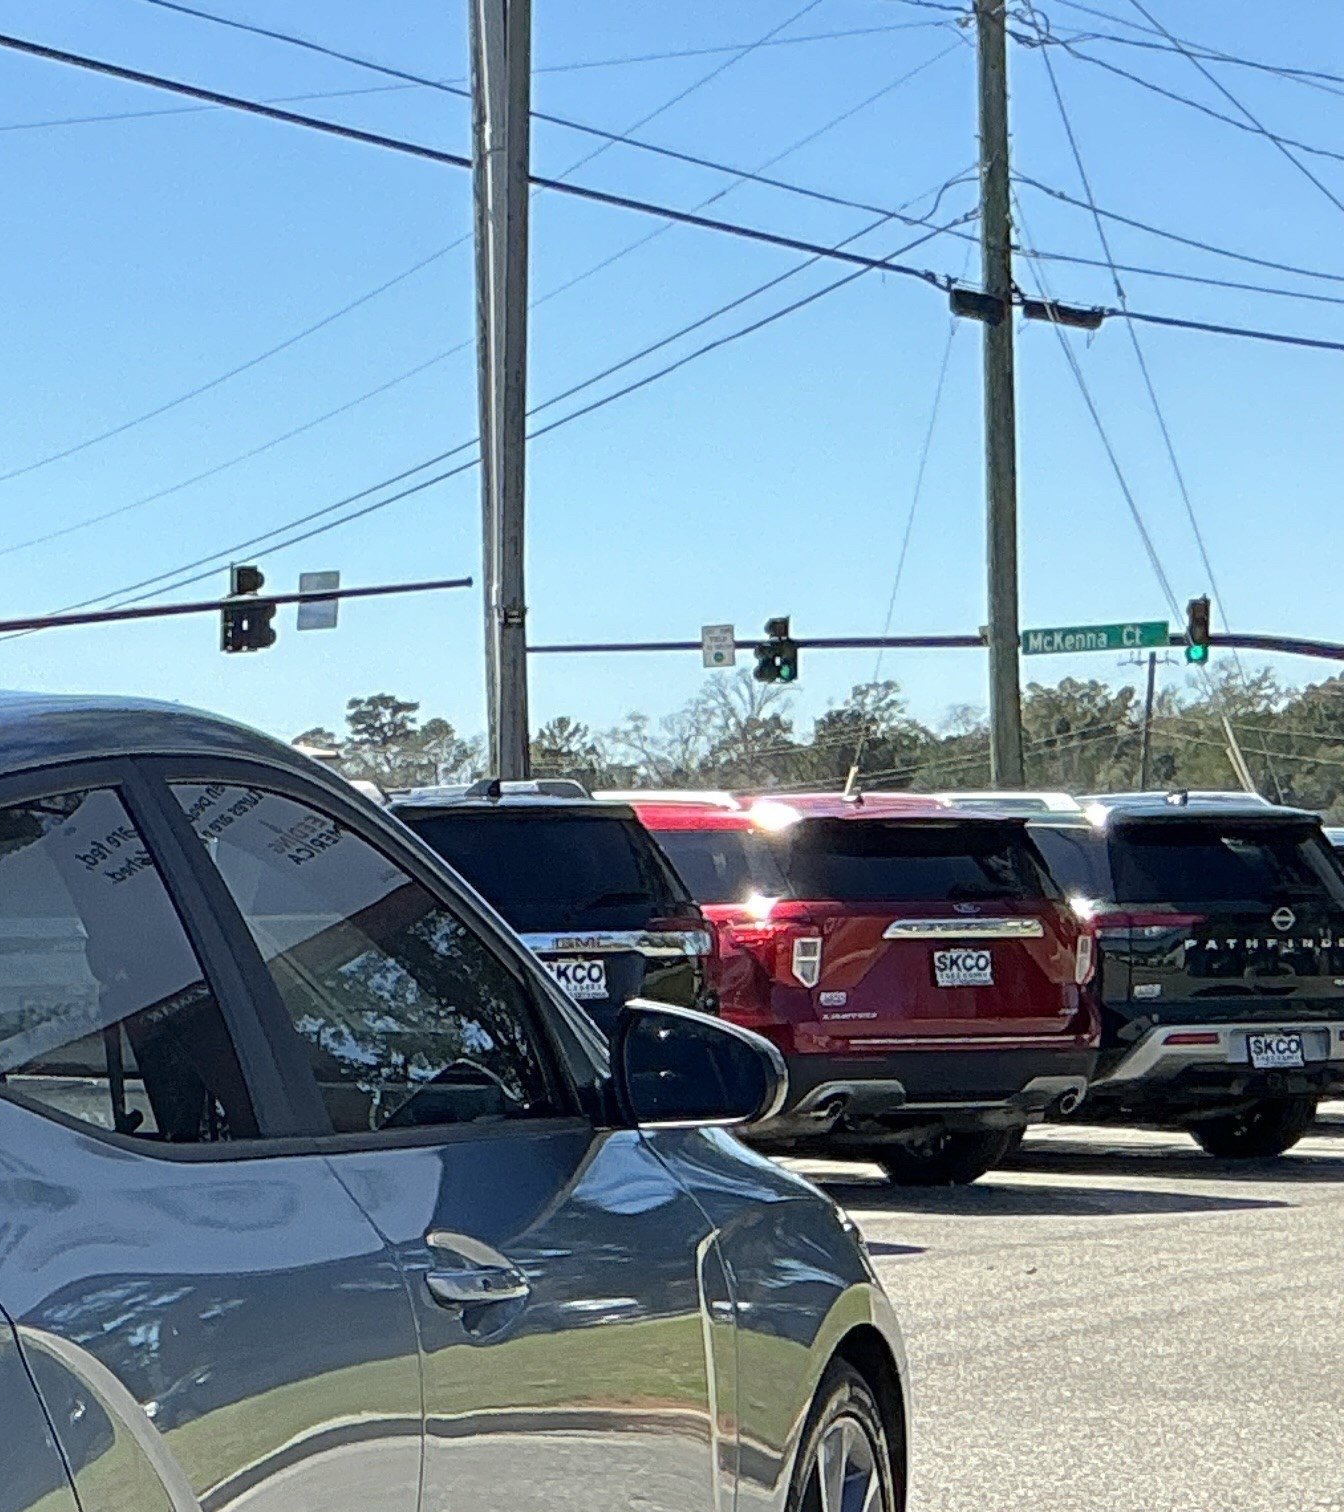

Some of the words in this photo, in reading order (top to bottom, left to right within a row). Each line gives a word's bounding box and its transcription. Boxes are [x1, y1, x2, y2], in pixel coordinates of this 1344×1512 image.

[1028, 629, 1109, 652] McKenna
[1121, 624, 1143, 647] Ct
[547, 962, 603, 983] KCO
[937, 953, 988, 972] SKCO
[1253, 1038, 1300, 1055] SKCO
